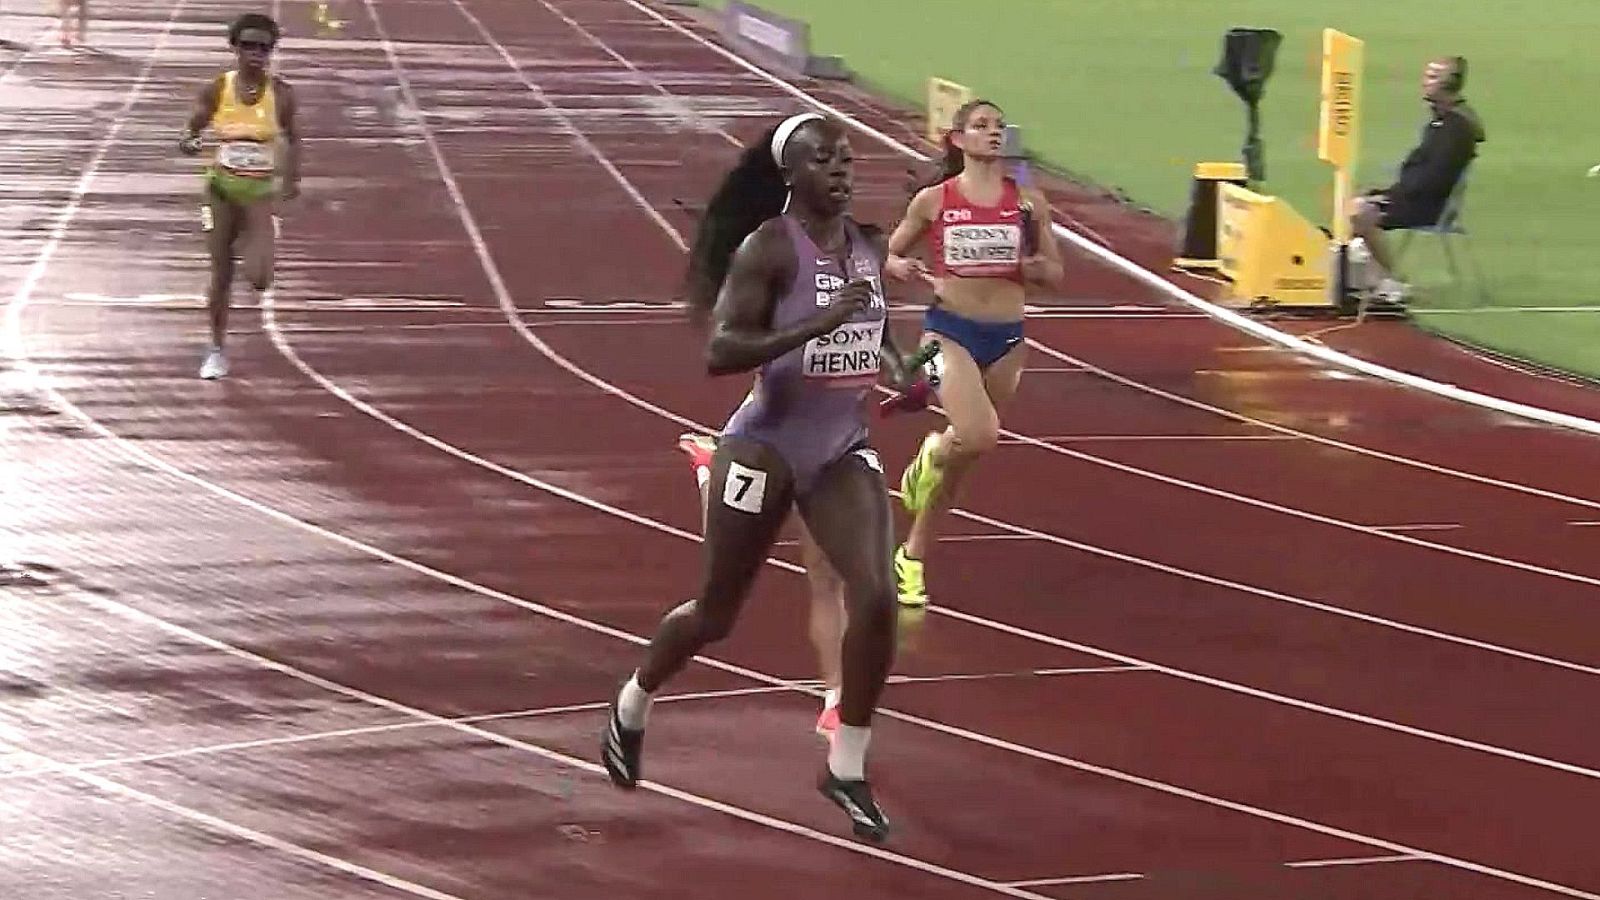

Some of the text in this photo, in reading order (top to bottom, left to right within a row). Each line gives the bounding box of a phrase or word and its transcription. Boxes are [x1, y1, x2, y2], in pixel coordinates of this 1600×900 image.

[817, 329, 874, 346] SONY
[810, 351, 881, 373] HENRY
[735, 474, 755, 501] 7
